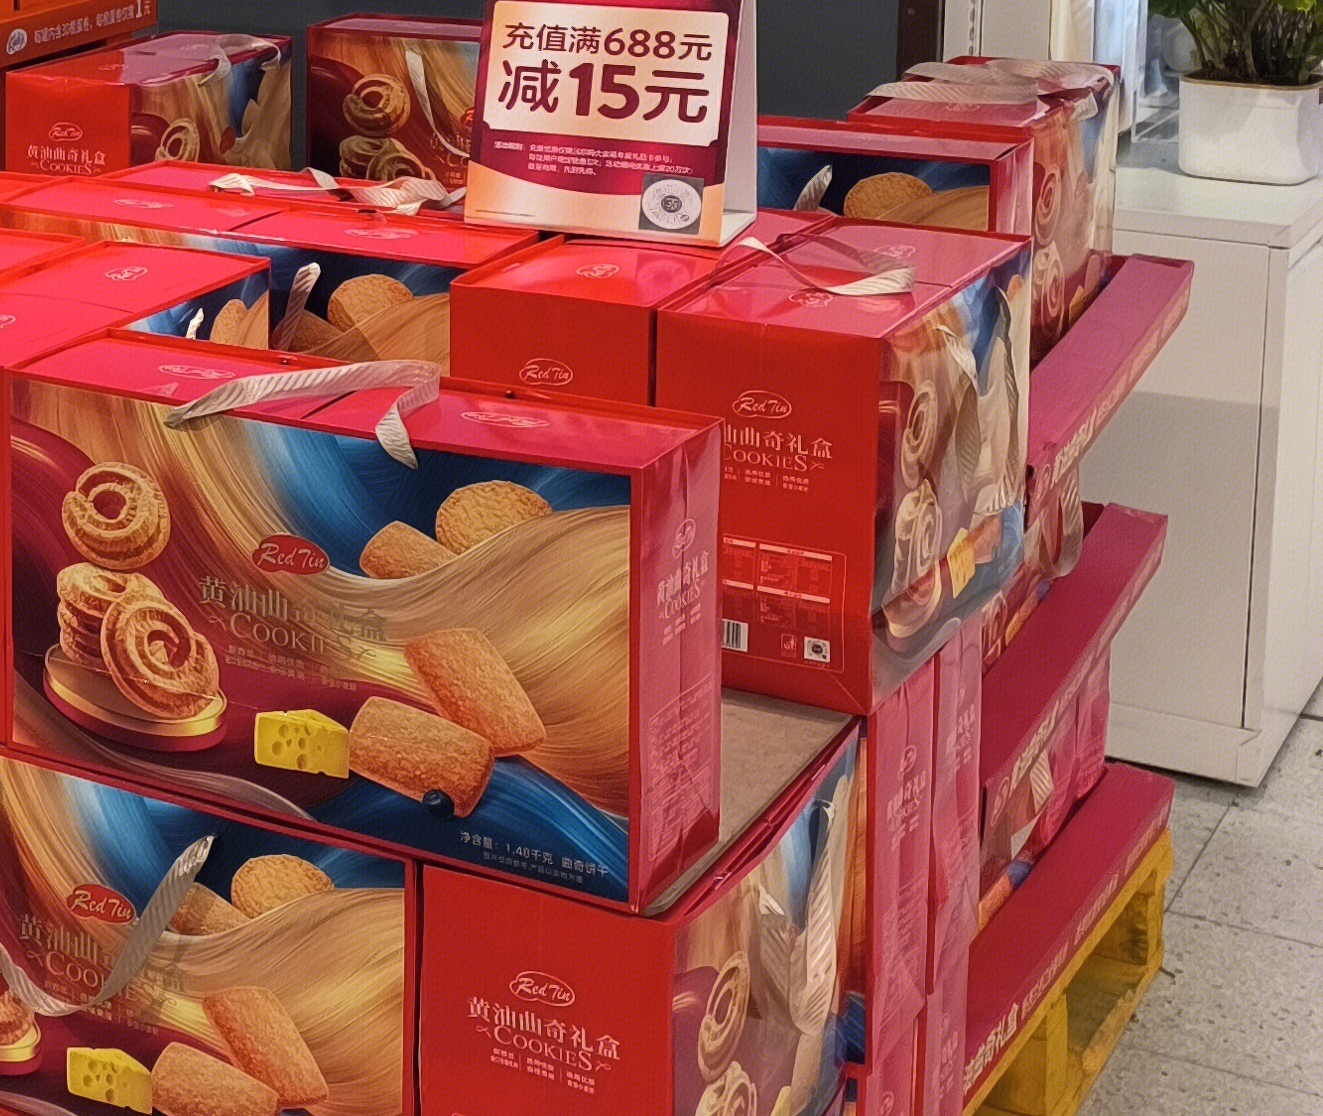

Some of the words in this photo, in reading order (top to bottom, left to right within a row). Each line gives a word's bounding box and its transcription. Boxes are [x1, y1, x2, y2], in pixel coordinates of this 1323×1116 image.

[503, 22, 713, 61] 充值满688元
[498, 59, 710, 124] 减15元
[40, 160, 91, 175] COOKIES
[738, 397, 766, 413] Red
[767, 399, 787, 414] Tin
[257, 543, 294, 567] Red
[299, 549, 325, 569] Tin
[562, 856, 608, 877] 曲奇饼干
[71, 890, 105, 914] Red
[108, 899, 131, 919] Tin
[516, 977, 547, 996] Red
[549, 984, 570, 1001] Tin
[467, 996, 620, 1061] 黄油曲奇礼盒
[494, 1025, 592, 1071] COOKIES
